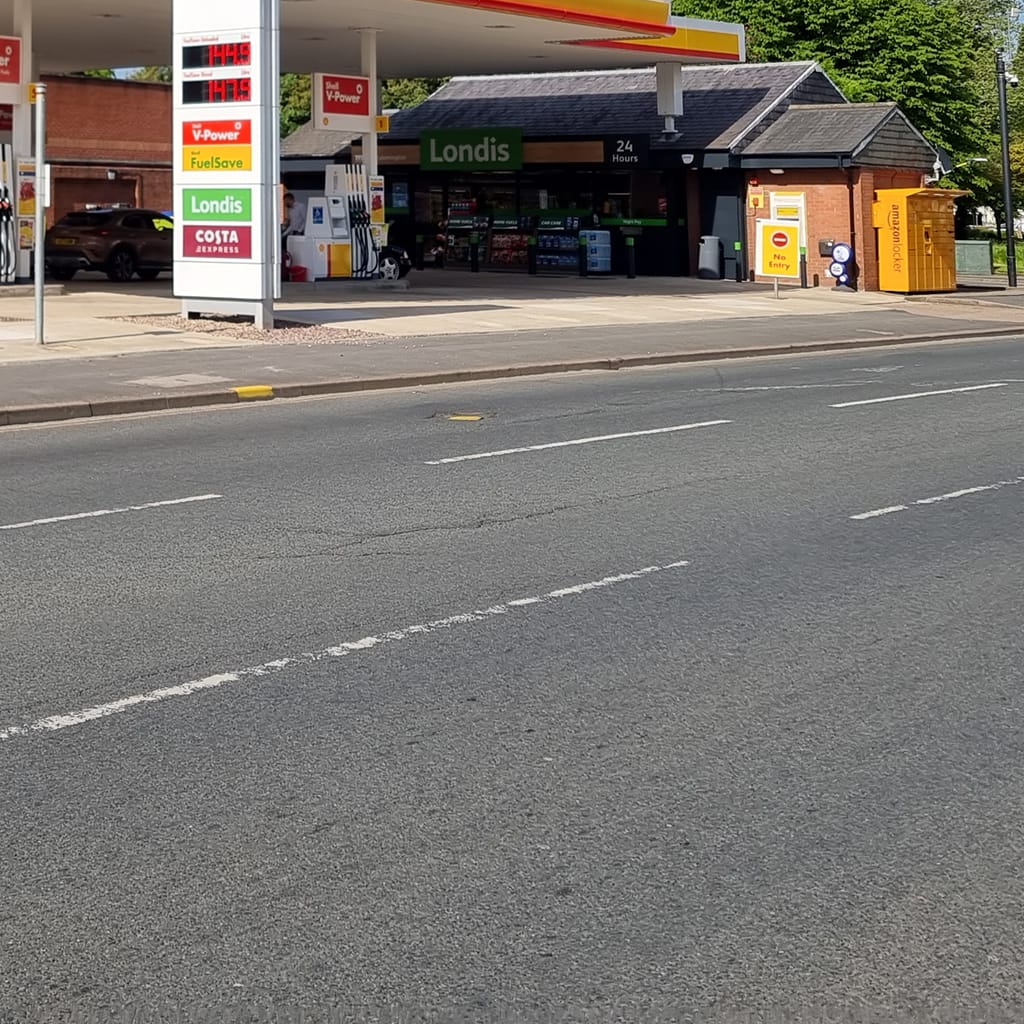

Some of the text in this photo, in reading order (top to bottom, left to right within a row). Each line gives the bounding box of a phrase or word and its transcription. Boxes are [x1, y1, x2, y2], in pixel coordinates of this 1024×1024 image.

[326, 90, 361, 104] V-Power
[192, 129, 240, 141] V-Power
[429, 137, 510, 164] Londis
[616, 140, 633, 152] 24
[191, 156, 243, 169] FuelSave
[612, 153, 638, 163] Hours
[191, 195, 243, 214] Londis
[195, 230, 239, 244] COSTA
[201, 246, 239, 254] EXPRESS
[773, 253, 786, 261] No
[769, 262, 791, 271] Entry
